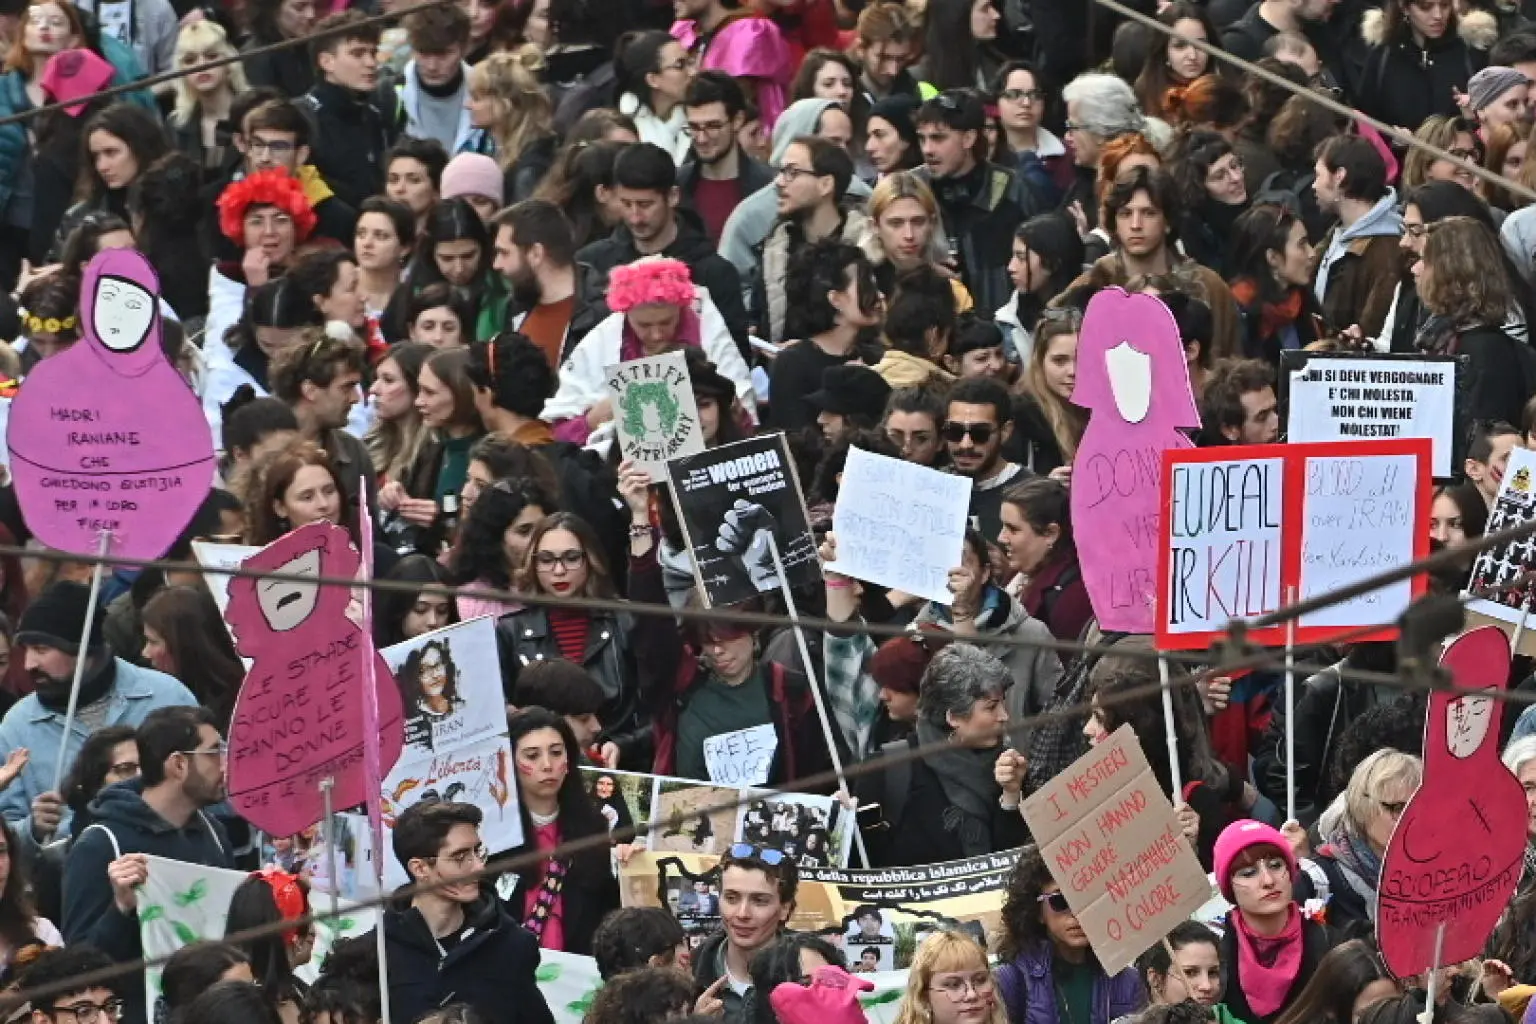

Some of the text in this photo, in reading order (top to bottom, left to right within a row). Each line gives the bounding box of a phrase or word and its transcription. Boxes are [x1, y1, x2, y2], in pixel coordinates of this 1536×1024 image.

[609, 363, 687, 392] PETRIFY
[1324, 369, 1337, 382] SI
[1339, 369, 1367, 383] DEVE
[1370, 370, 1445, 386] VERGOGNARE
[1340, 387, 1361, 401] CHI
[51, 407, 99, 422] MADRI
[1331, 405, 1413, 420] NON CHI VIENE
[67, 431, 140, 446] IRANIANE
[80, 456, 110, 469] CHE
[54, 499, 77, 512] PER
[1170, 462, 1205, 537] EU
[1208, 463, 1280, 534] DEAL
[1205, 539, 1275, 621] KILL
[235, 661, 355, 742] SICURE LE
[248, 674, 275, 701] LE
[229, 718, 301, 767] FANNO
[322, 690, 352, 724] LE
[279, 720, 344, 774] DONNE
[1047, 746, 1130, 822] I MESTIERI
[1055, 789, 1147, 873] NON HANNO
[816, 869, 849, 883] della
[851, 869, 926, 886] repubblica
[928, 859, 989, 880] islamica
[1071, 842, 1118, 893] GENERE
[1107, 875, 1182, 942] O COLORE
